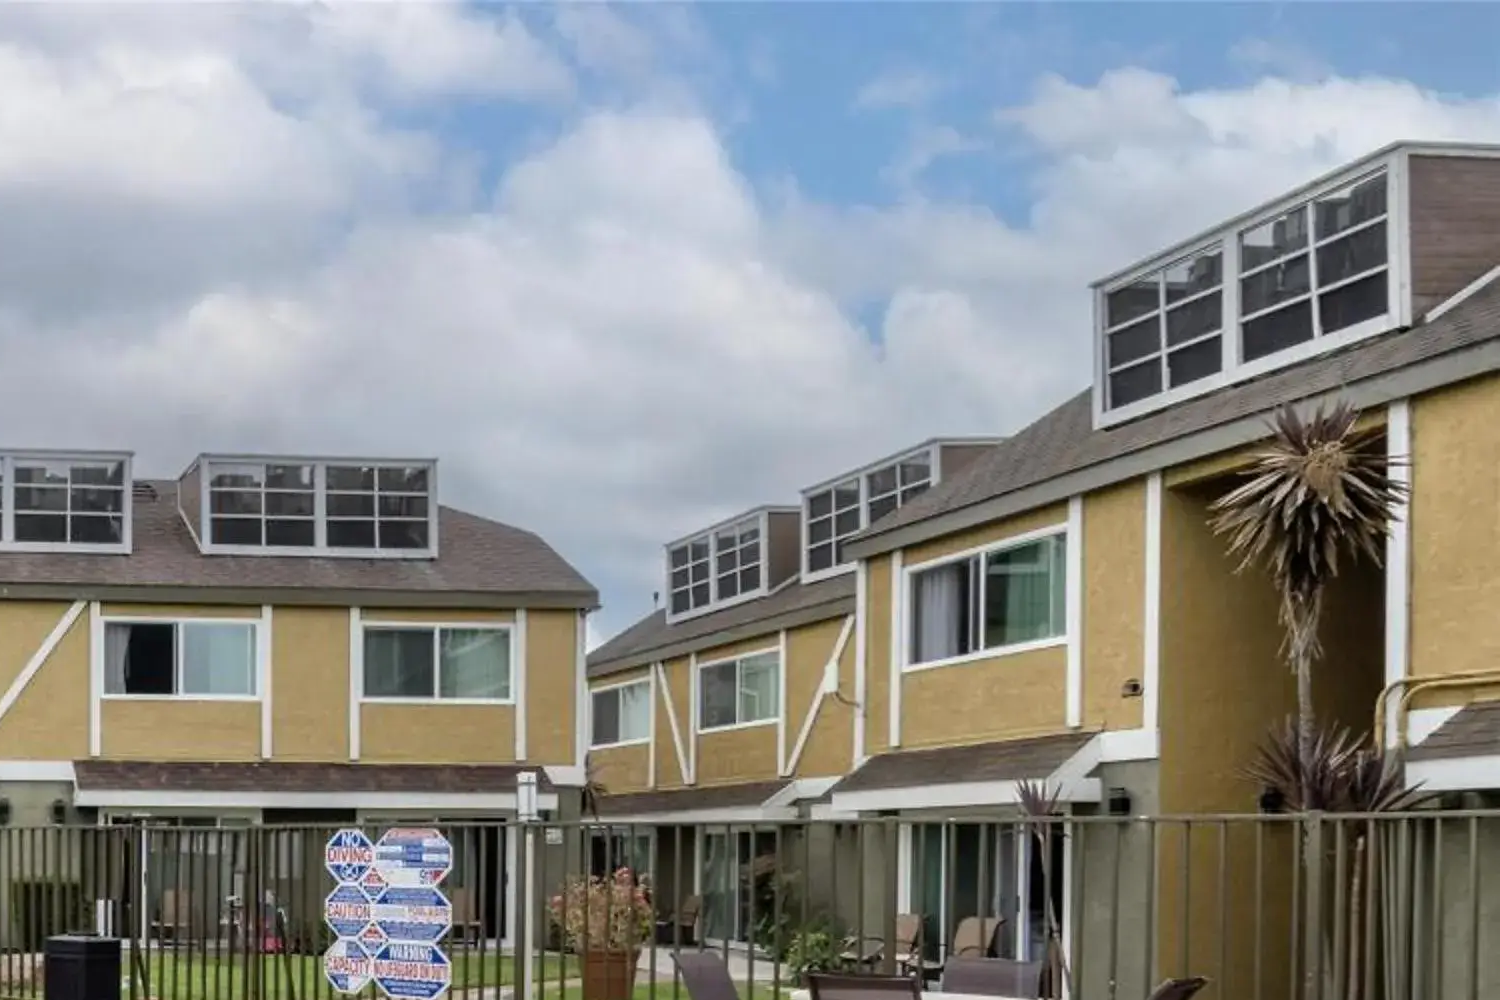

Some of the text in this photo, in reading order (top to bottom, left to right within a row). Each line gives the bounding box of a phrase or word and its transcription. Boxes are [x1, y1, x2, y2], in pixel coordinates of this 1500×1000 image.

[341, 832, 361, 847] NO
[328, 848, 372, 863] DIVING
[328, 903, 370, 918] CAUTION
[390, 944, 433, 962] WARNING
[328, 957, 370, 976] CAPACITY
